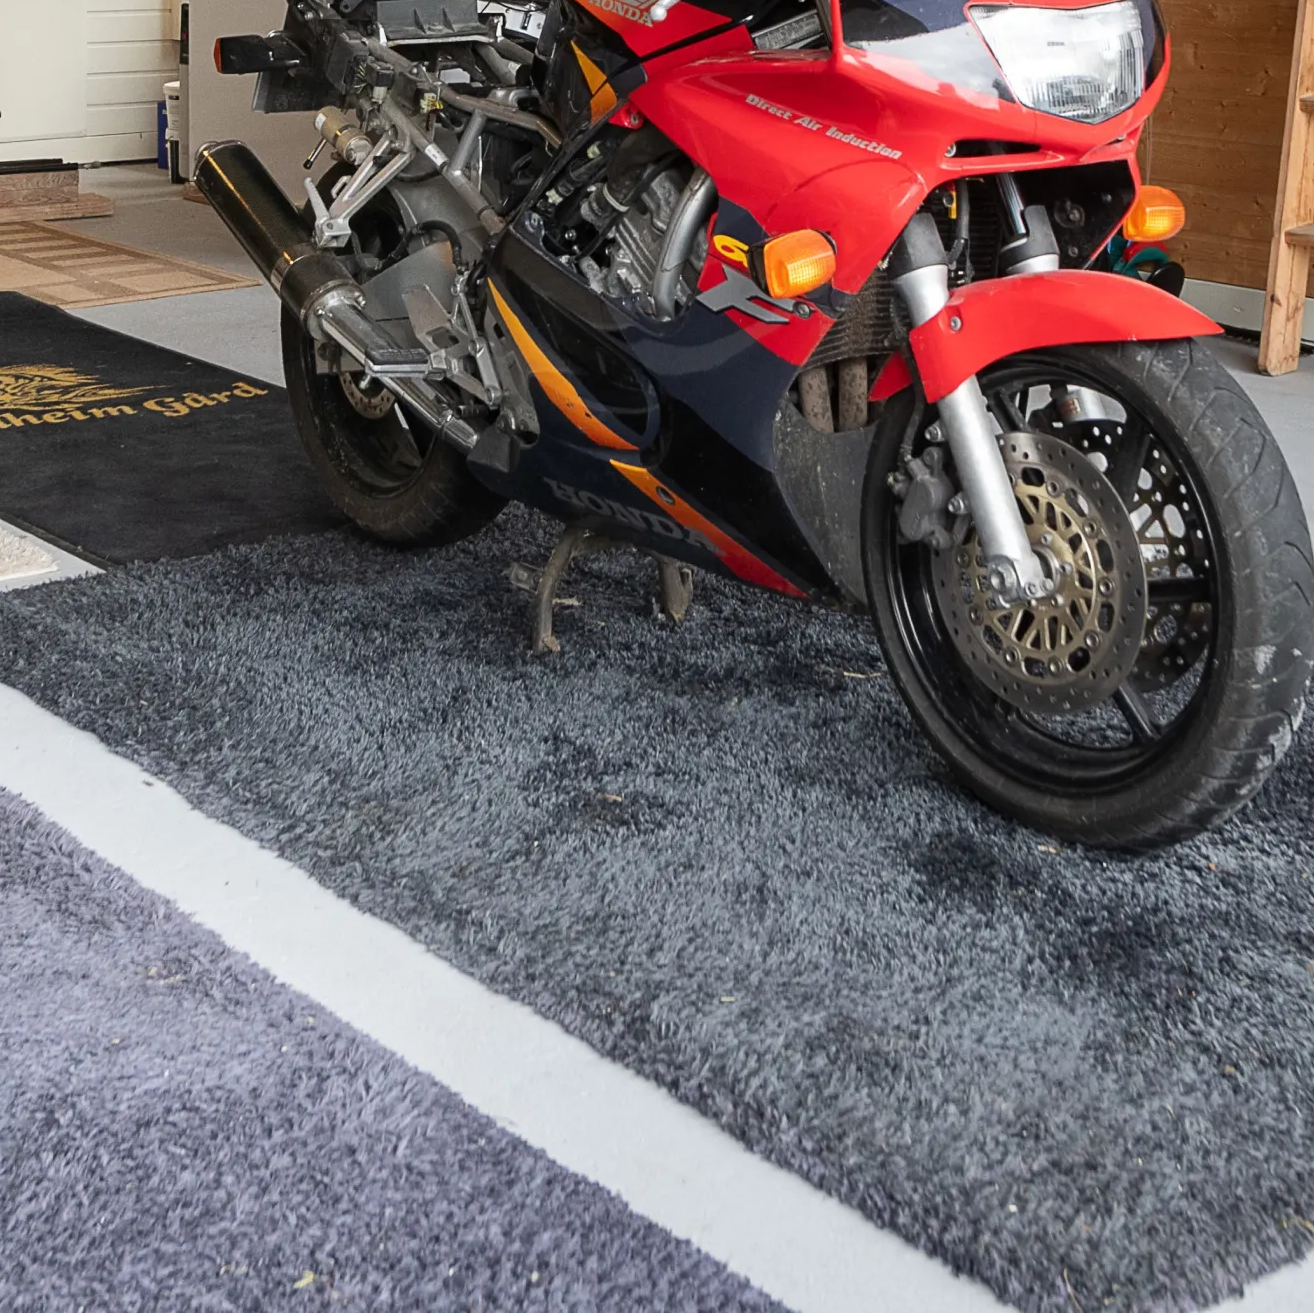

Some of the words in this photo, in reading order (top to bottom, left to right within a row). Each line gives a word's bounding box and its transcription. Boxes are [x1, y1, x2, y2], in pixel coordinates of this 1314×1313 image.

[745, 93, 793, 120] Direct
[794, 115, 823, 132] Air
[825, 126, 903, 160] Induction
[143, 382, 269, 418] Gård
[543, 476, 727, 556] HONDA
